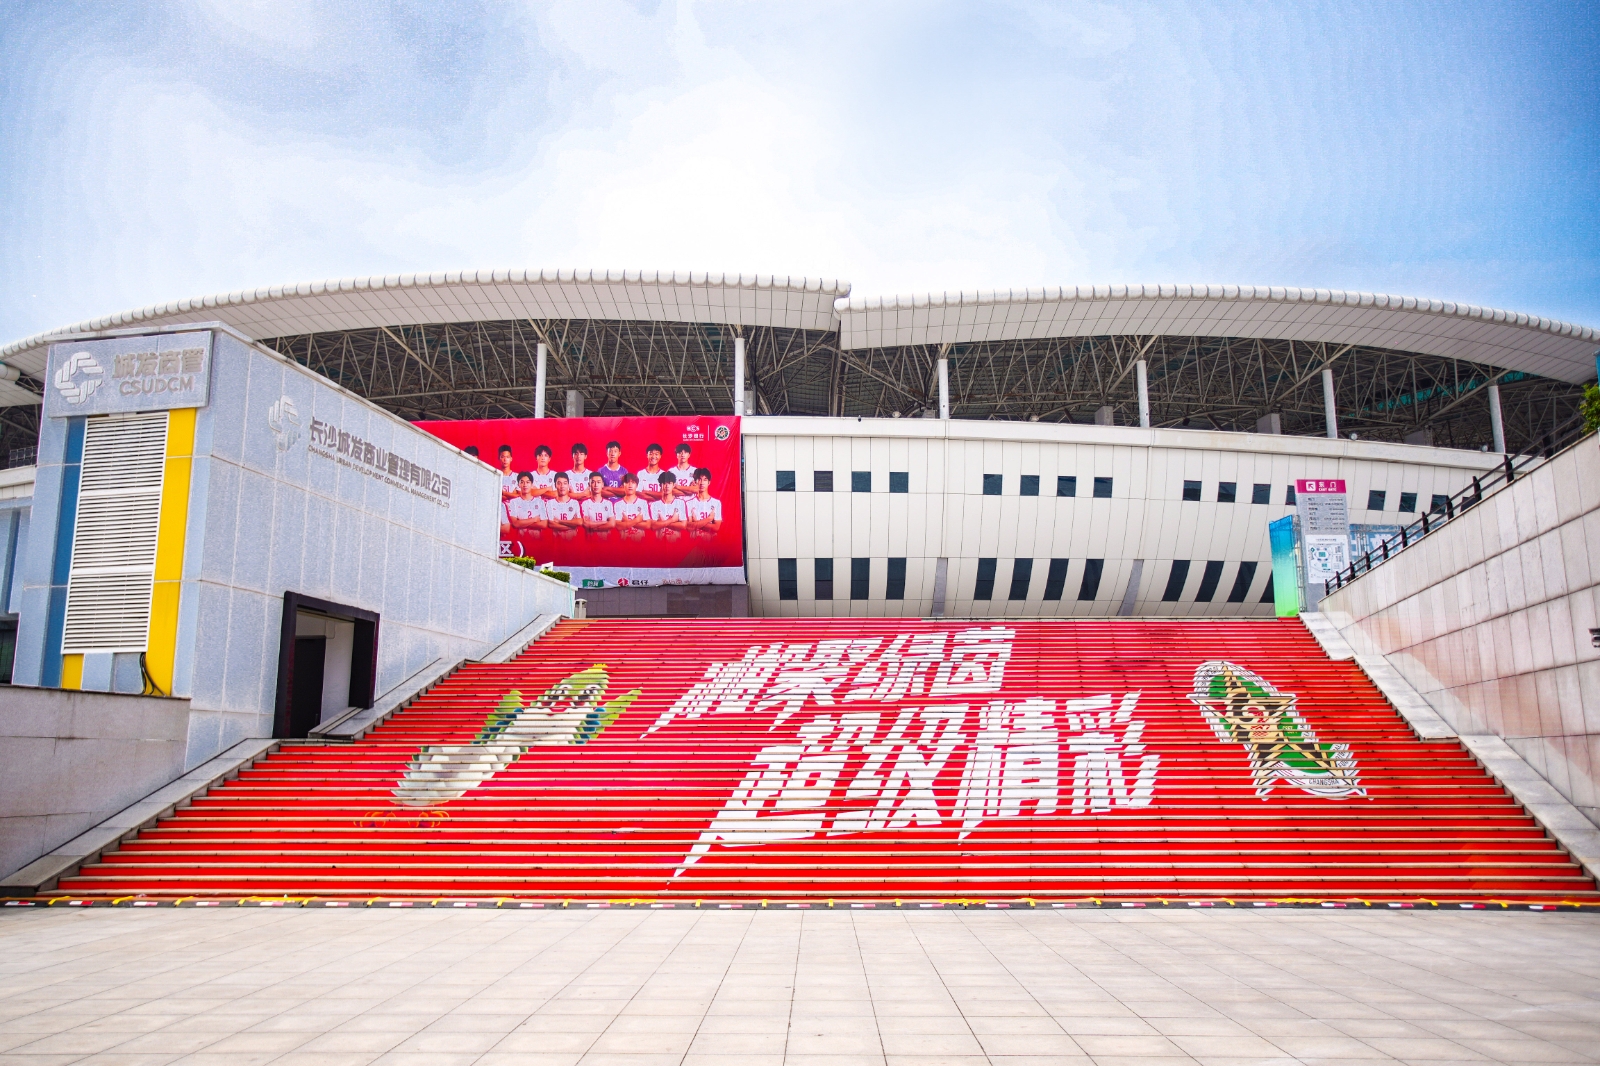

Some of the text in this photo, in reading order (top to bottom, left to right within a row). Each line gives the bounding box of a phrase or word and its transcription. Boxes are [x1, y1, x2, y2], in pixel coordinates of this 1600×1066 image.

[113, 348, 204, 378] 城发商管
[119, 376, 195, 396] CSUDCM
[308, 444, 336, 461] CHANGSHA
[310, 416, 451, 499] 长沙城发商业管理有限公司
[668, 690, 1160, 882] 超级精彩
